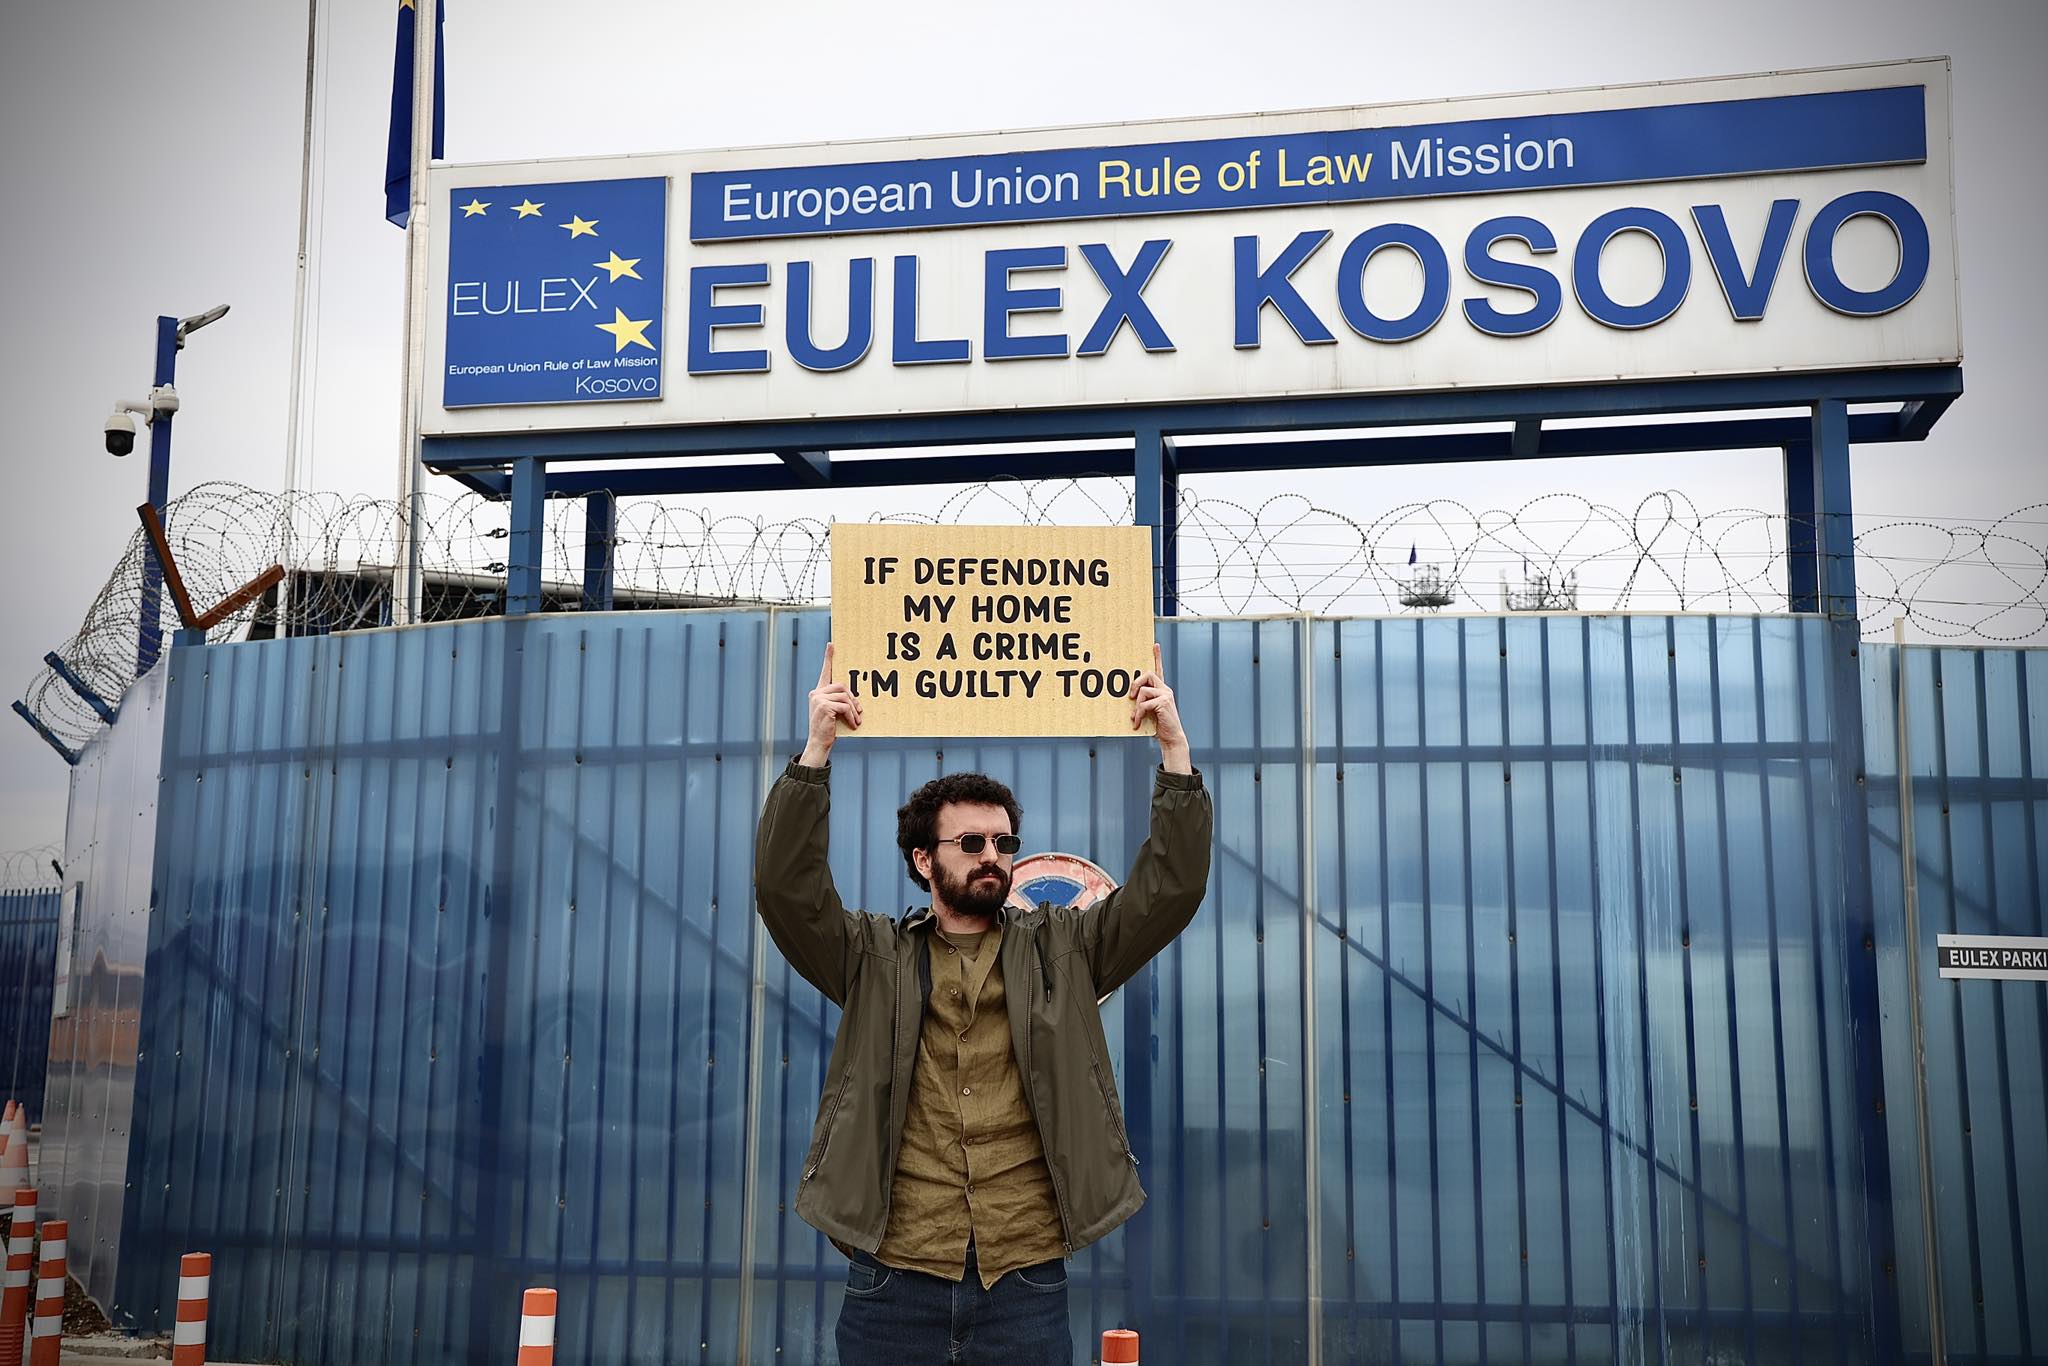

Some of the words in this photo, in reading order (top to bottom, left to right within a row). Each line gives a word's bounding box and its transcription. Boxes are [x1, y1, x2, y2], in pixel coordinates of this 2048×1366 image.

[723, 181, 932, 225] European
[950, 166, 1080, 208] Union
[1098, 157, 1200, 198] Rule
[1217, 150, 1261, 191] of
[1278, 149, 1373, 188] Law
[1391, 133, 1574, 180] Mission
[453, 276, 598, 316] EULEX
[687, 239, 1177, 377] EULEX
[1234, 190, 1930, 350] KOSOVO
[449, 363, 504, 375] European
[508, 362, 541, 373] Union
[544, 361, 569, 371] Rule
[572, 358, 585, 369] of
[587, 357, 611, 369] Law
[614, 356, 658, 367] Mission
[575, 376, 657, 394] Kosovo
[864, 557, 898, 584] IF
[915, 558, 1109, 587] DEFENDING
[904, 595, 955, 622] MY
[972, 595, 1072, 623] HOME
[887, 632, 920, 660] IS
[936, 633, 957, 660] A
[973, 633, 1091, 663] CRIME,
[849, 670, 898, 697] I'M
[916, 670, 1042, 698] GUILTY
[1950, 950, 1999, 966] EULEX
[2002, 951, 2047, 967] PARKI
